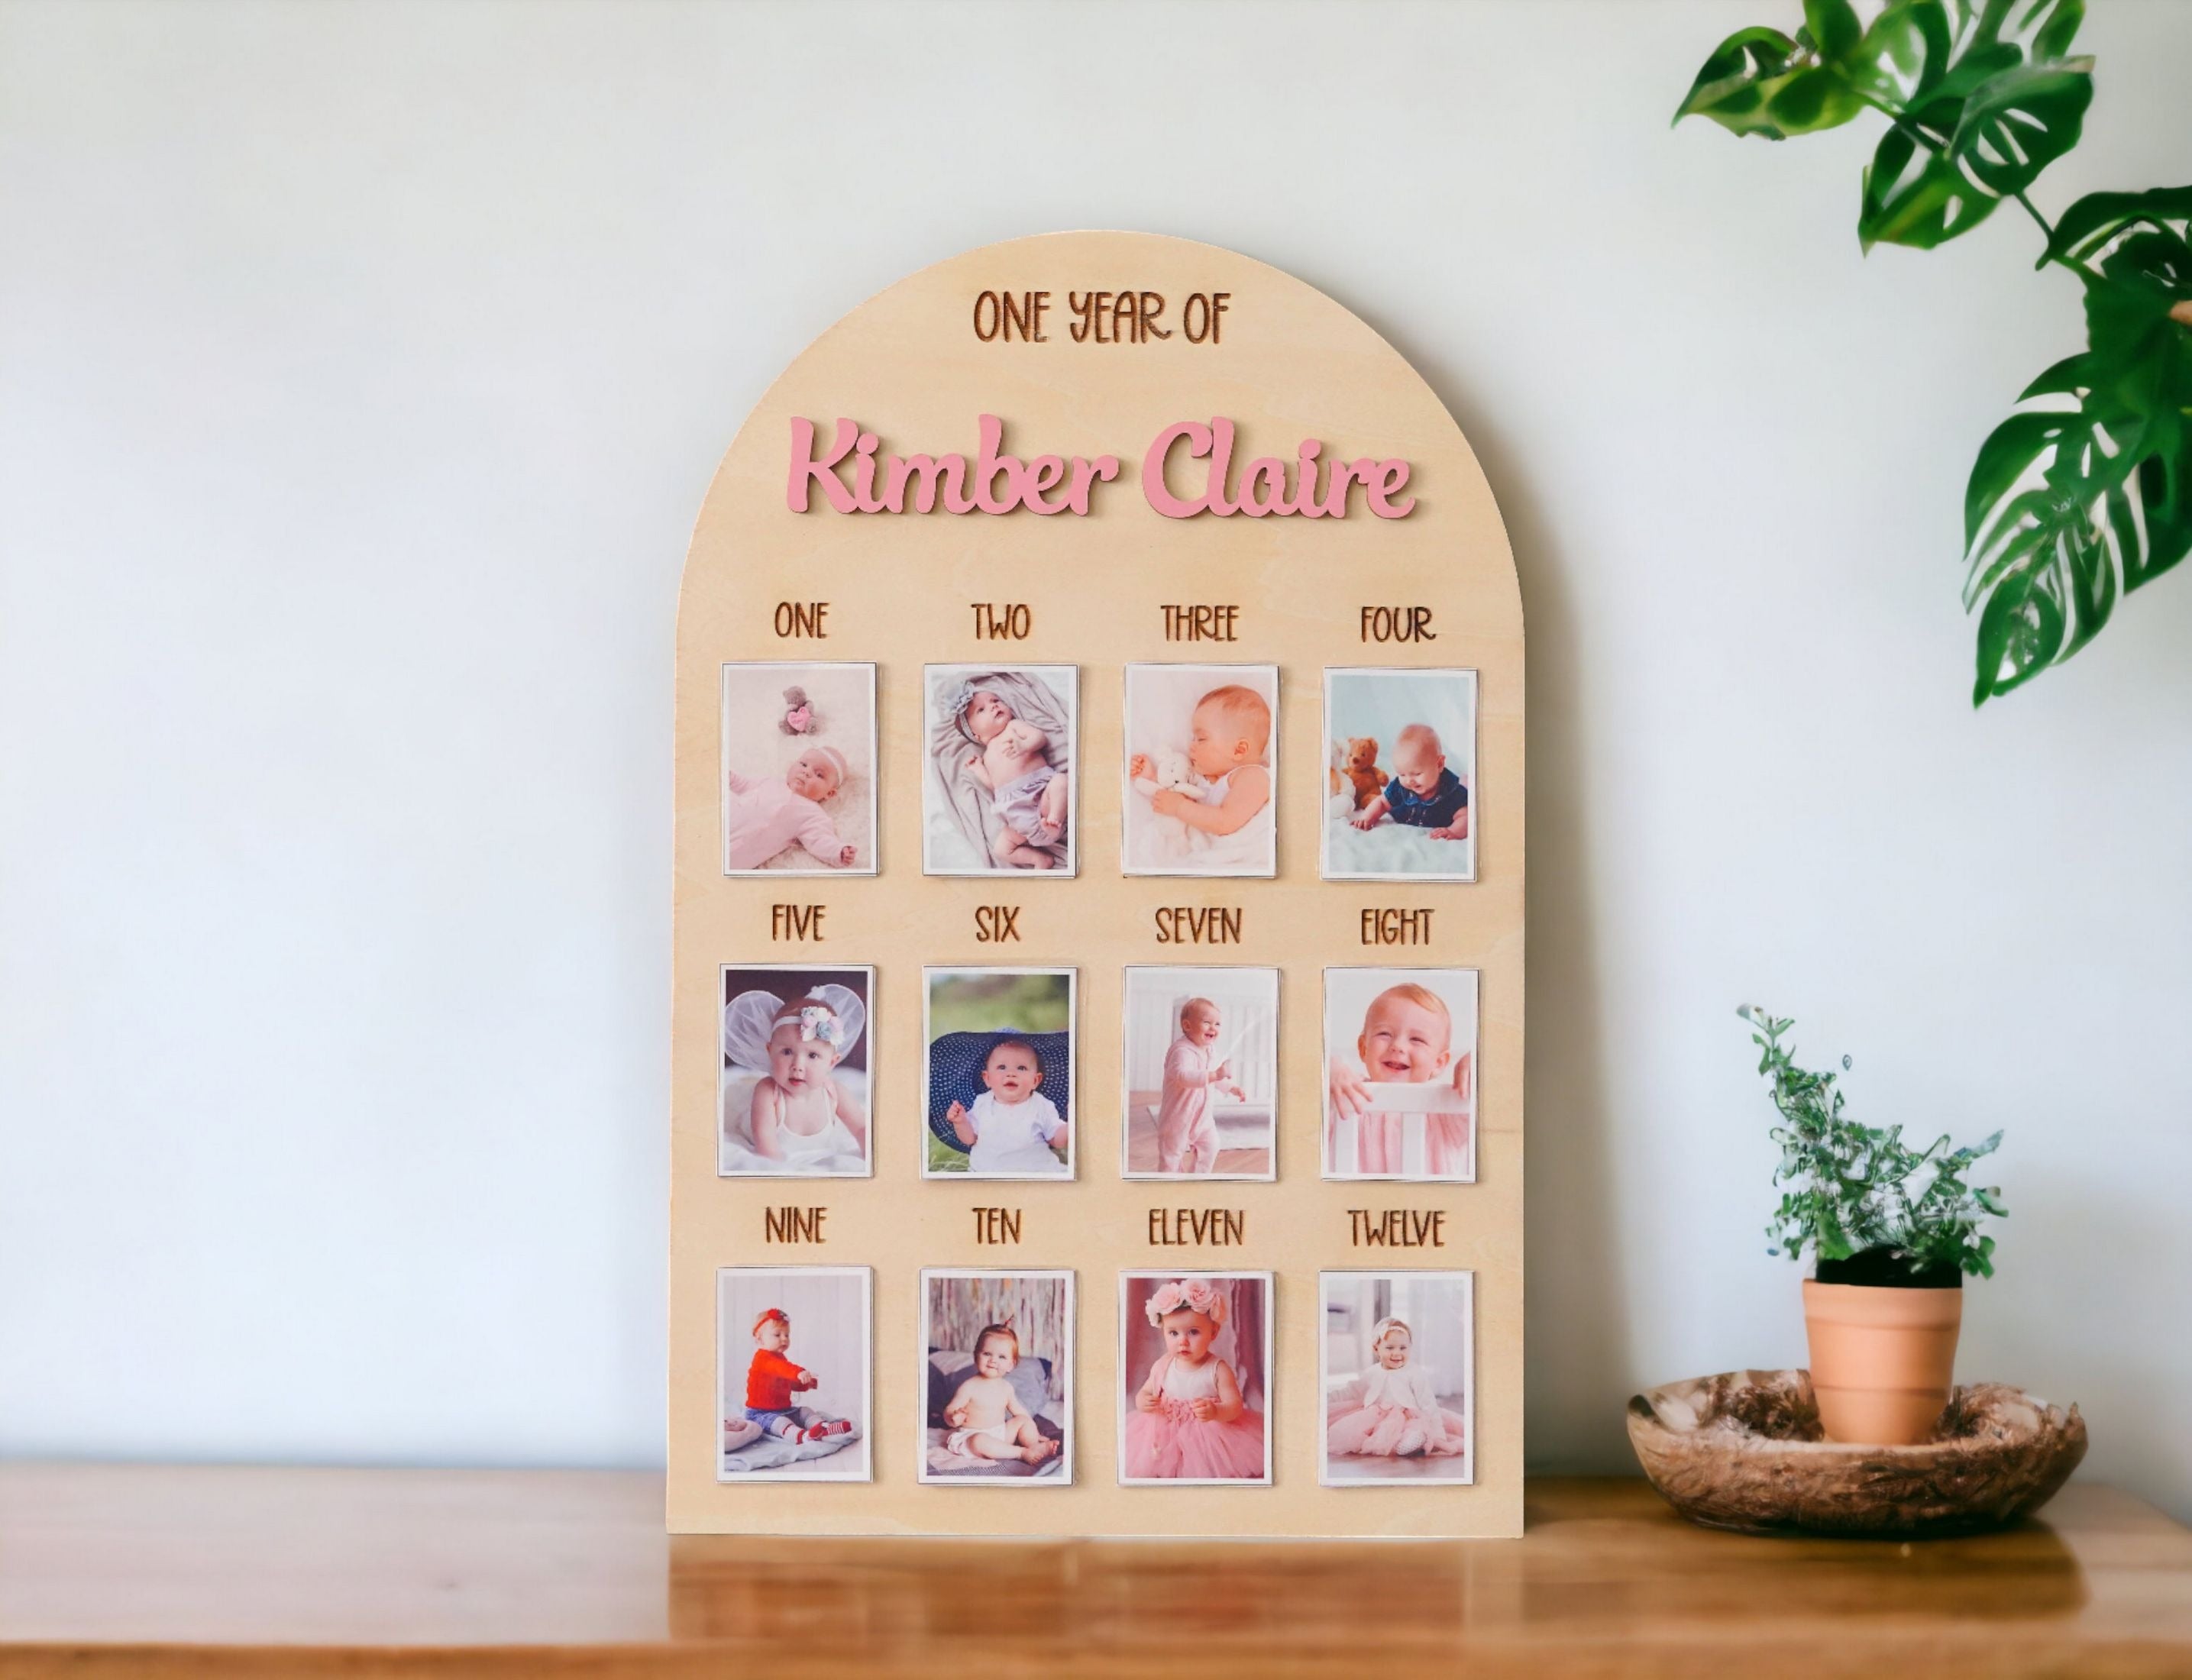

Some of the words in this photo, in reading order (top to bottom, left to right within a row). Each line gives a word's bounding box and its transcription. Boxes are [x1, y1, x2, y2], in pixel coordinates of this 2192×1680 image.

[973, 290, 1051, 343] ONE
[1069, 290, 1172, 344] YEAR
[1183, 292, 1231, 344] OF
[787, 414, 1120, 516] Kimber
[1141, 417, 1417, 519] Claire
[774, 601, 829, 640] ONE
[969, 602, 1031, 641] TWO
[1159, 604, 1240, 643] THREE
[1360, 606, 1437, 645] FOUR
[771, 903, 826, 942] FIVE
[974, 905, 1021, 943] SIX
[1154, 906, 1243, 945] SEVEN
[1360, 907, 1436, 946] EIGHT
[765, 1205, 828, 1245] NINE
[971, 1207, 1022, 1245] TEN
[1148, 1208, 1245, 1247] ELEVEN
[1346, 1209, 1446, 1248] TWELVE
